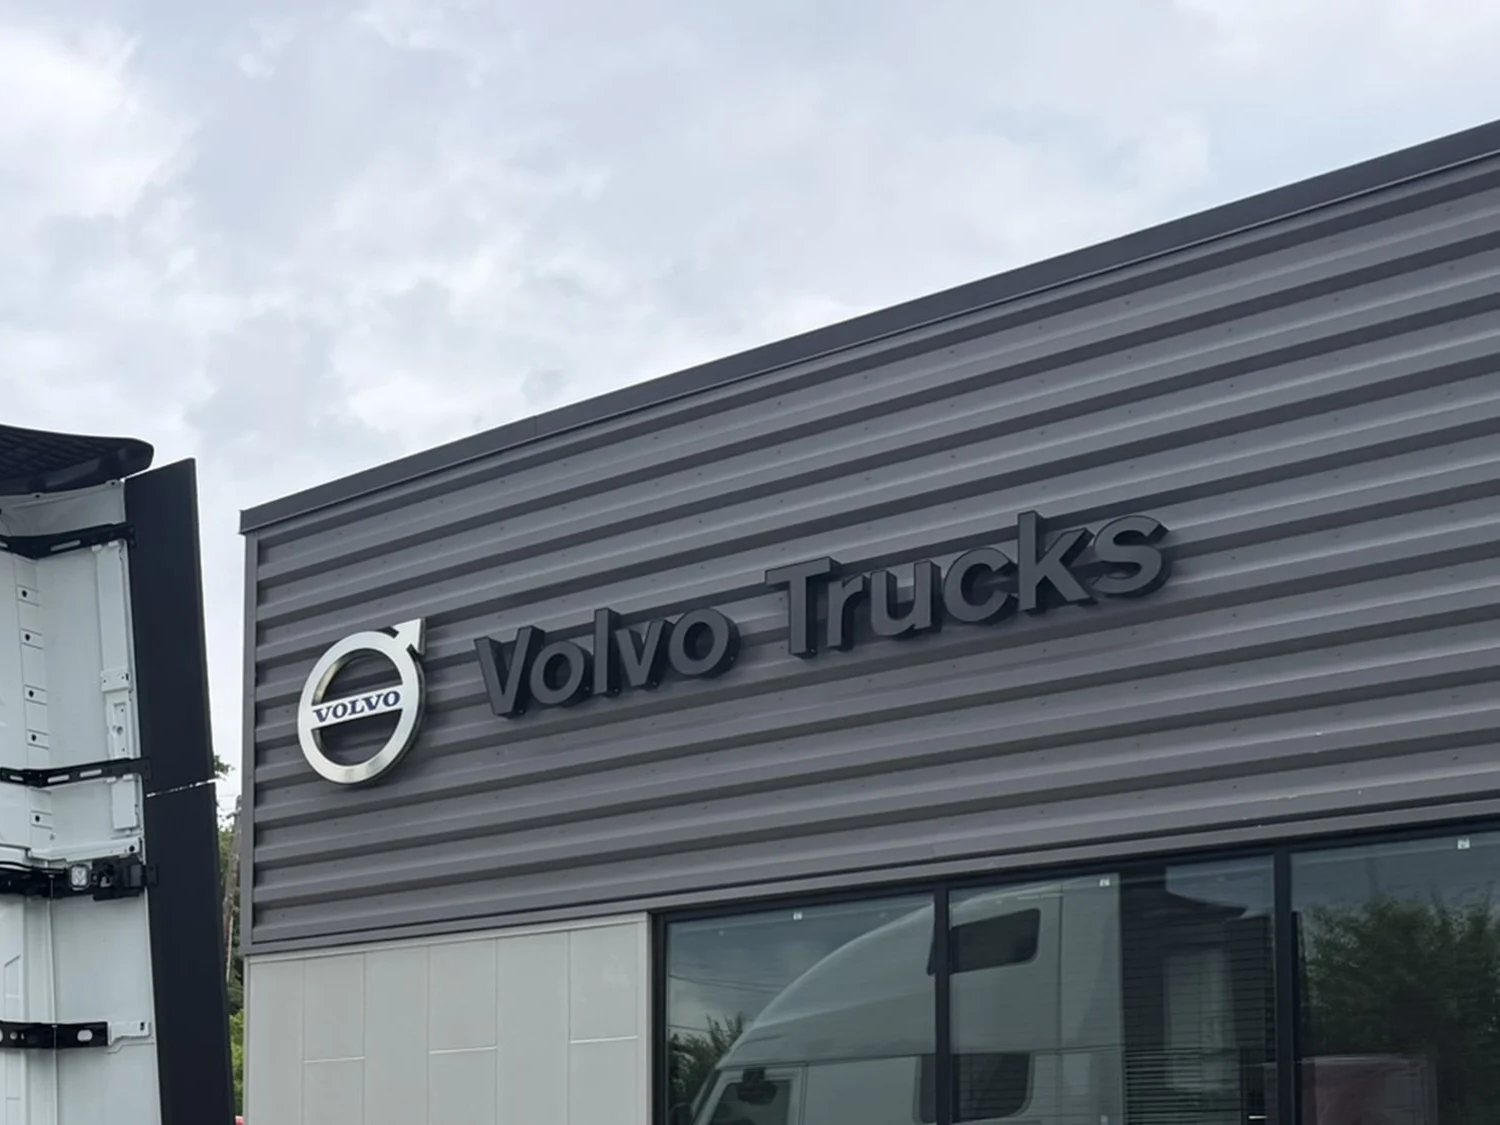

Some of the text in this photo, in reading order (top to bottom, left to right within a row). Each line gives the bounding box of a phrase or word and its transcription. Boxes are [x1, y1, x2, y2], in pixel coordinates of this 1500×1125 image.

[474, 509, 1169, 718] Volvo Trucks
[313, 690, 402, 723] VOLVO
